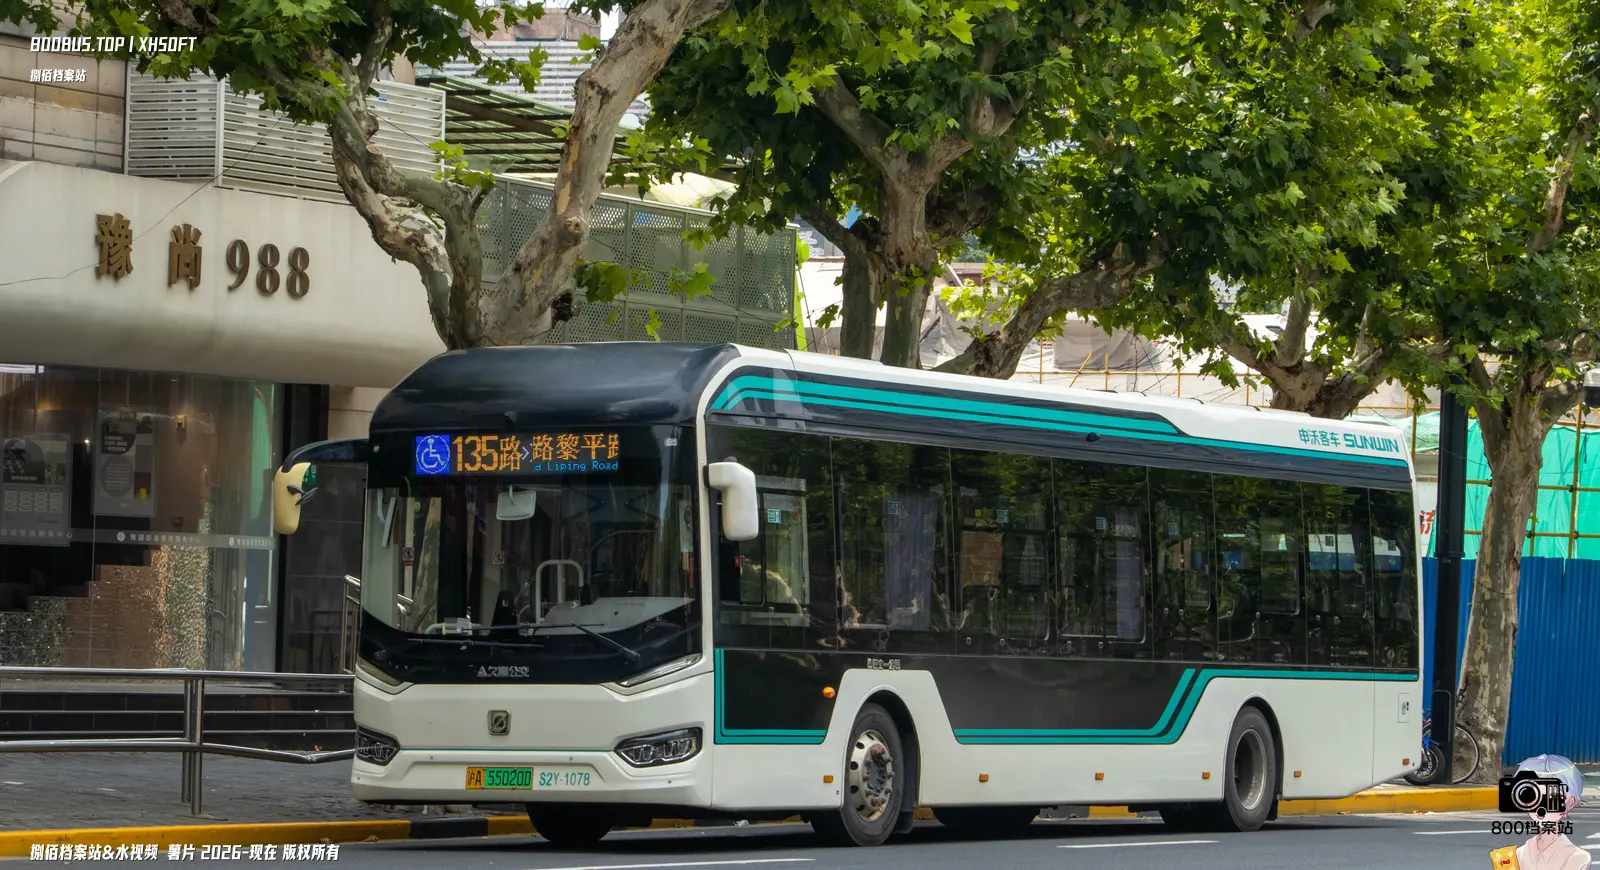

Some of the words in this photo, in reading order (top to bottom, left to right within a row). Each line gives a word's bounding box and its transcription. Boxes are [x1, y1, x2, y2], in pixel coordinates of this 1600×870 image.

[226, 239, 311, 300] 988
[1298, 428, 1341, 447] 申沃客车
[1343, 433, 1399, 452] SUNWIN
[547, 460, 587, 472] Liping
[592, 460, 619, 470] Road
[539, 772, 590, 786] S2Y-1078
